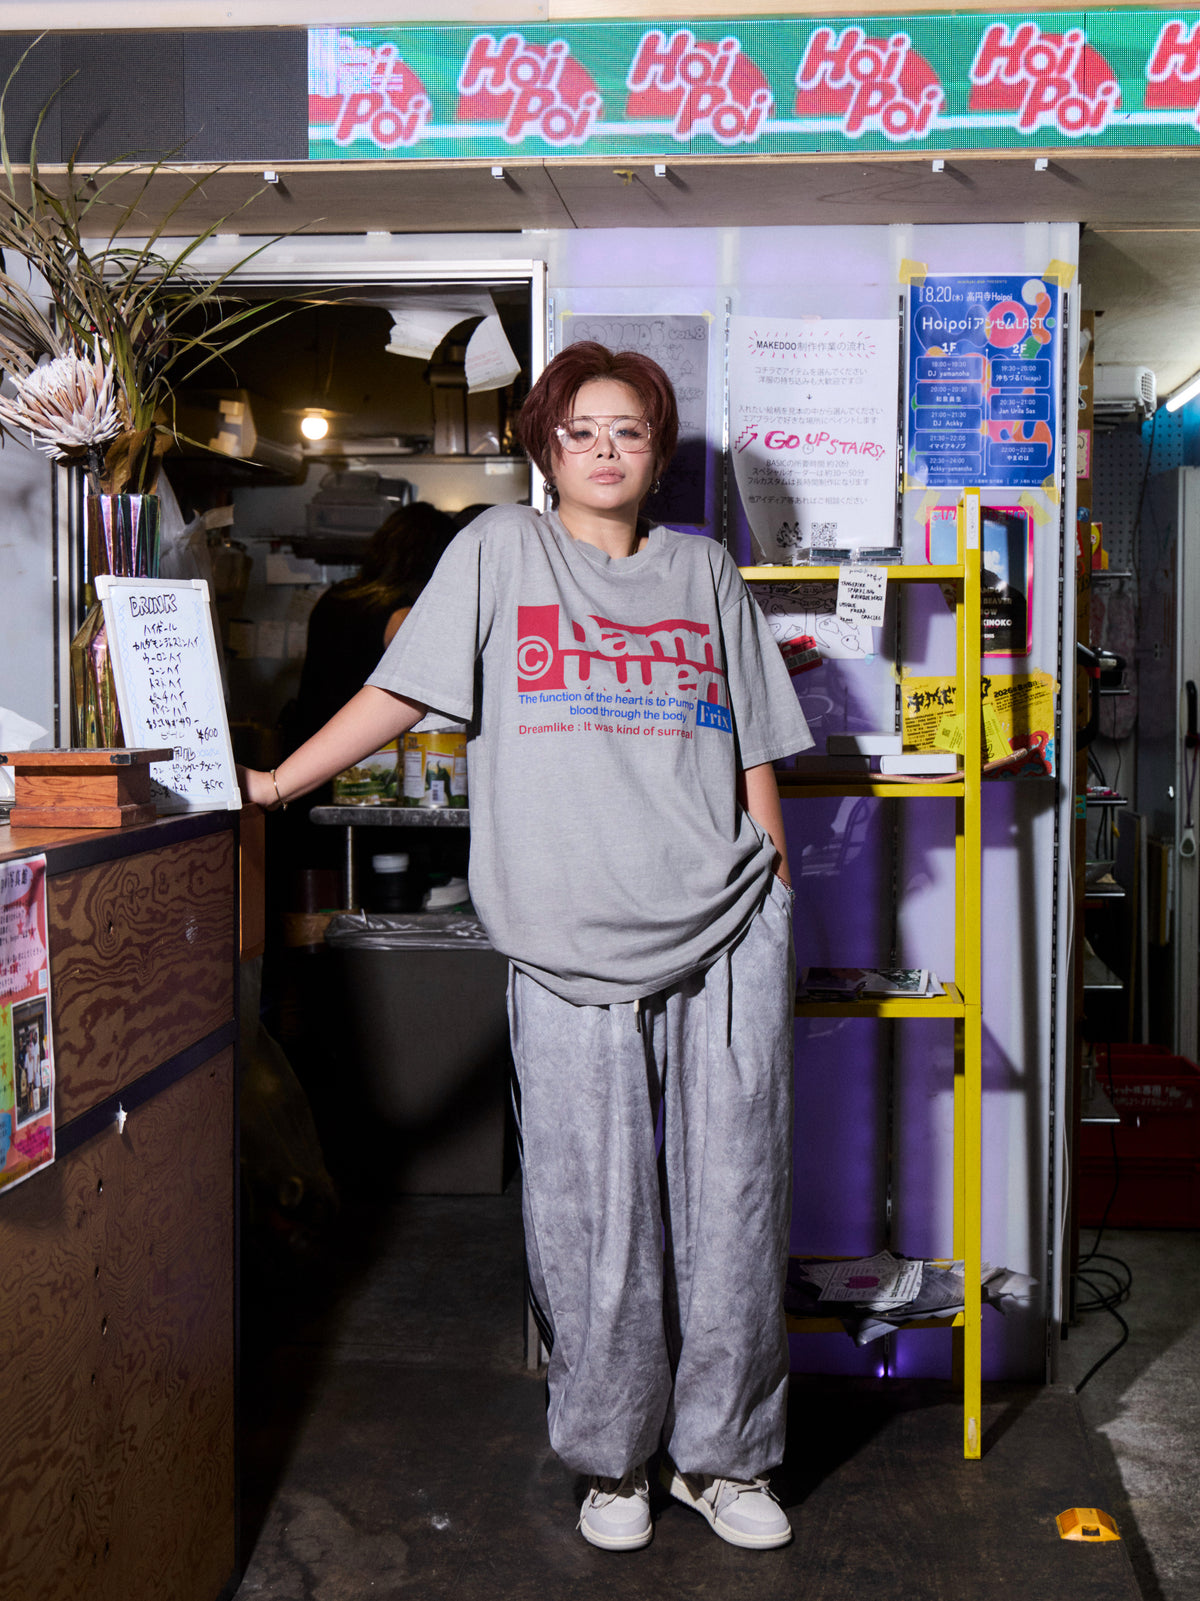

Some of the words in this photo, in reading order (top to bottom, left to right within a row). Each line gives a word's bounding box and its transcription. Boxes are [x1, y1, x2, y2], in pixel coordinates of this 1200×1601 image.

[458, 33, 569, 91] Hoi
[626, 30, 740, 90] Hoi
[796, 26, 911, 88] Hoi
[970, 21, 1086, 84] Hoi
[335, 90, 432, 148] Poi
[502, 87, 602, 145] Poi
[673, 85, 773, 145] Poi
[843, 78, 944, 141] Poi
[1016, 74, 1121, 137] Poi
[942, 342, 957, 352] 1F
[1012, 344, 1027, 354] 2F
[764, 431, 800, 450] GO
[518, 694, 538, 704] The
[540, 692, 582, 702] function
[584, 692, 594, 701] of
[596, 692, 612, 703] the
[615, 694, 643, 706] heart
[645, 696, 654, 706] is
[656, 697, 666, 706] to
[668, 698, 694, 711] Pump
[570, 706, 598, 715] blood
[600, 706, 640, 721] through
[644, 710, 660, 720] the
[662, 711, 688, 724] body
[700, 705, 730, 730] Frix
[196, 727, 218, 744] ¥600
[518, 722, 574, 734] Dreamlike
[584, 722, 592, 731] It
[594, 723, 614, 733] was
[616, 724, 640, 735] kind
[644, 726, 656, 736] of
[658, 728, 693, 740] surreal
